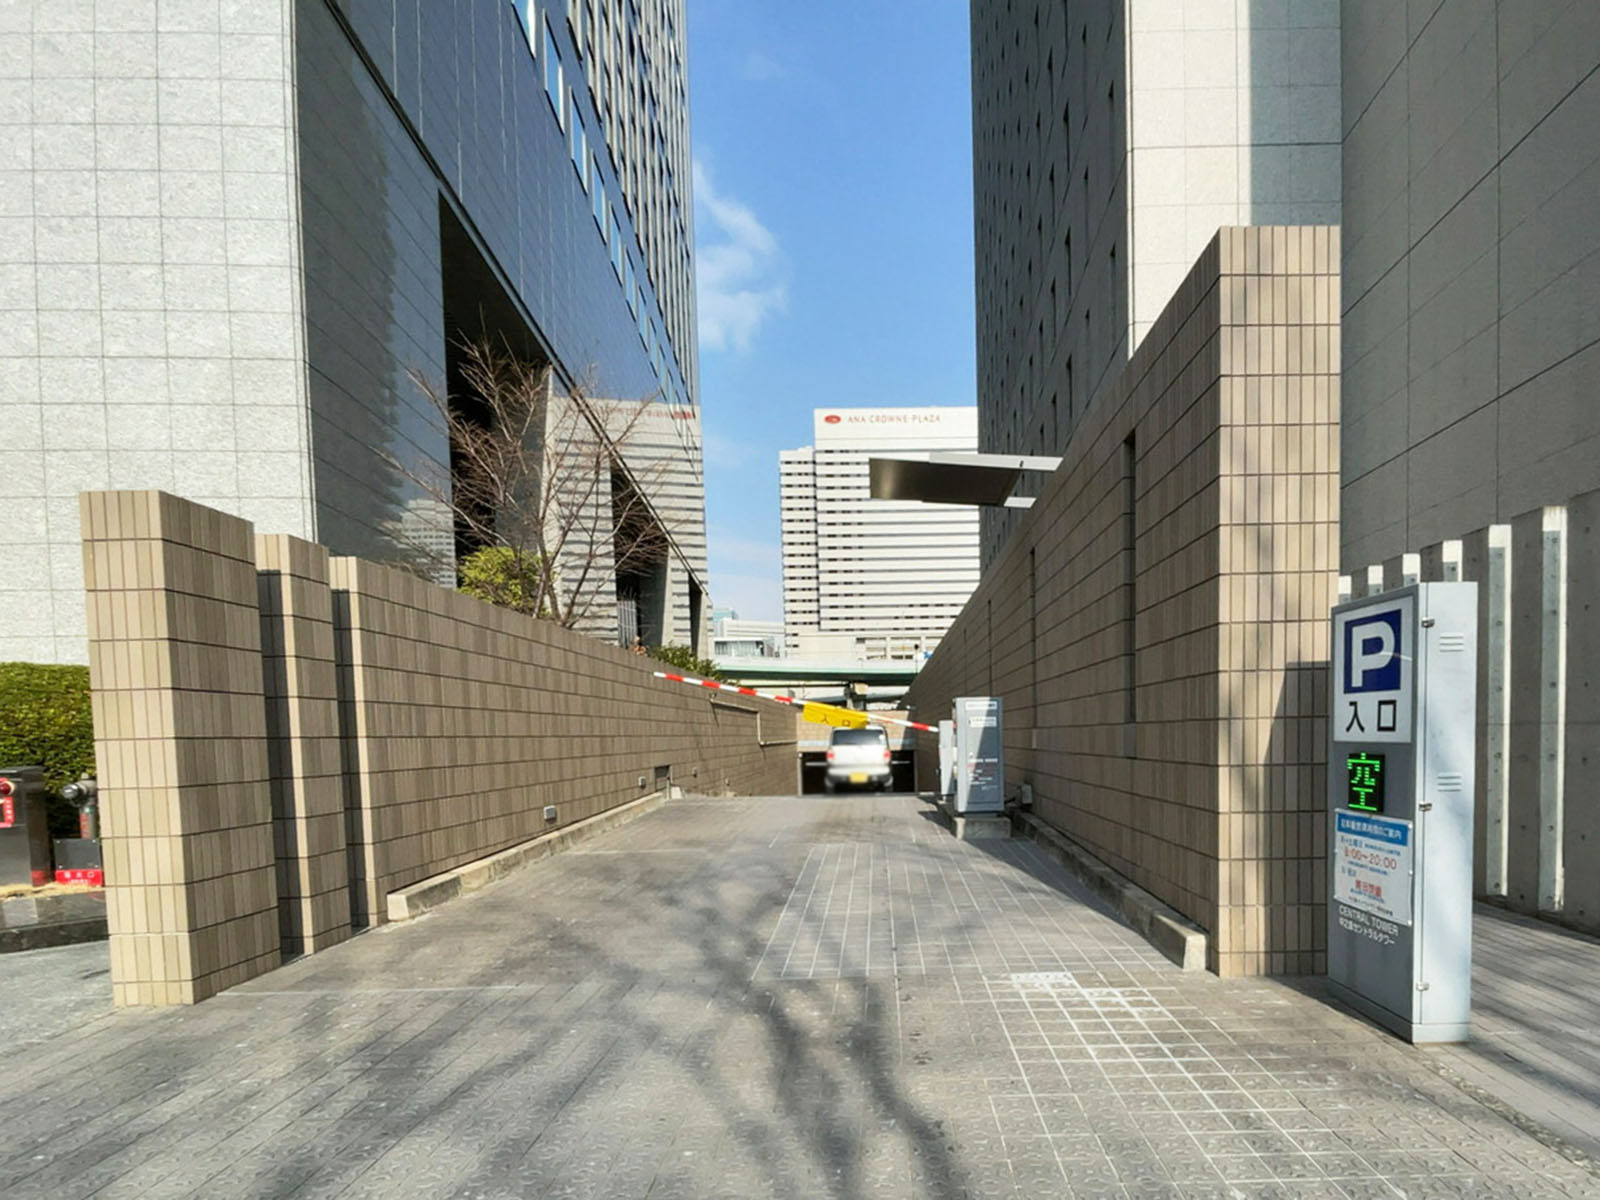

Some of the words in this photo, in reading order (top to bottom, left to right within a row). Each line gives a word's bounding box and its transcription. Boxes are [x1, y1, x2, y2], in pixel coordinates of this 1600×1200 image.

[847, 415, 866, 424] ANA
[868, 414, 908, 424] CROWNE
[911, 414, 941, 424] PLAZA
[1351, 620, 1396, 688] P
[820, 714, 851, 727] 入口
[1345, 700, 1397, 733] 入口
[1347, 752, 1380, 811] 空
[1339, 904, 1370, 925] CENTRAL
[1371, 916, 1398, 936] TOWER
